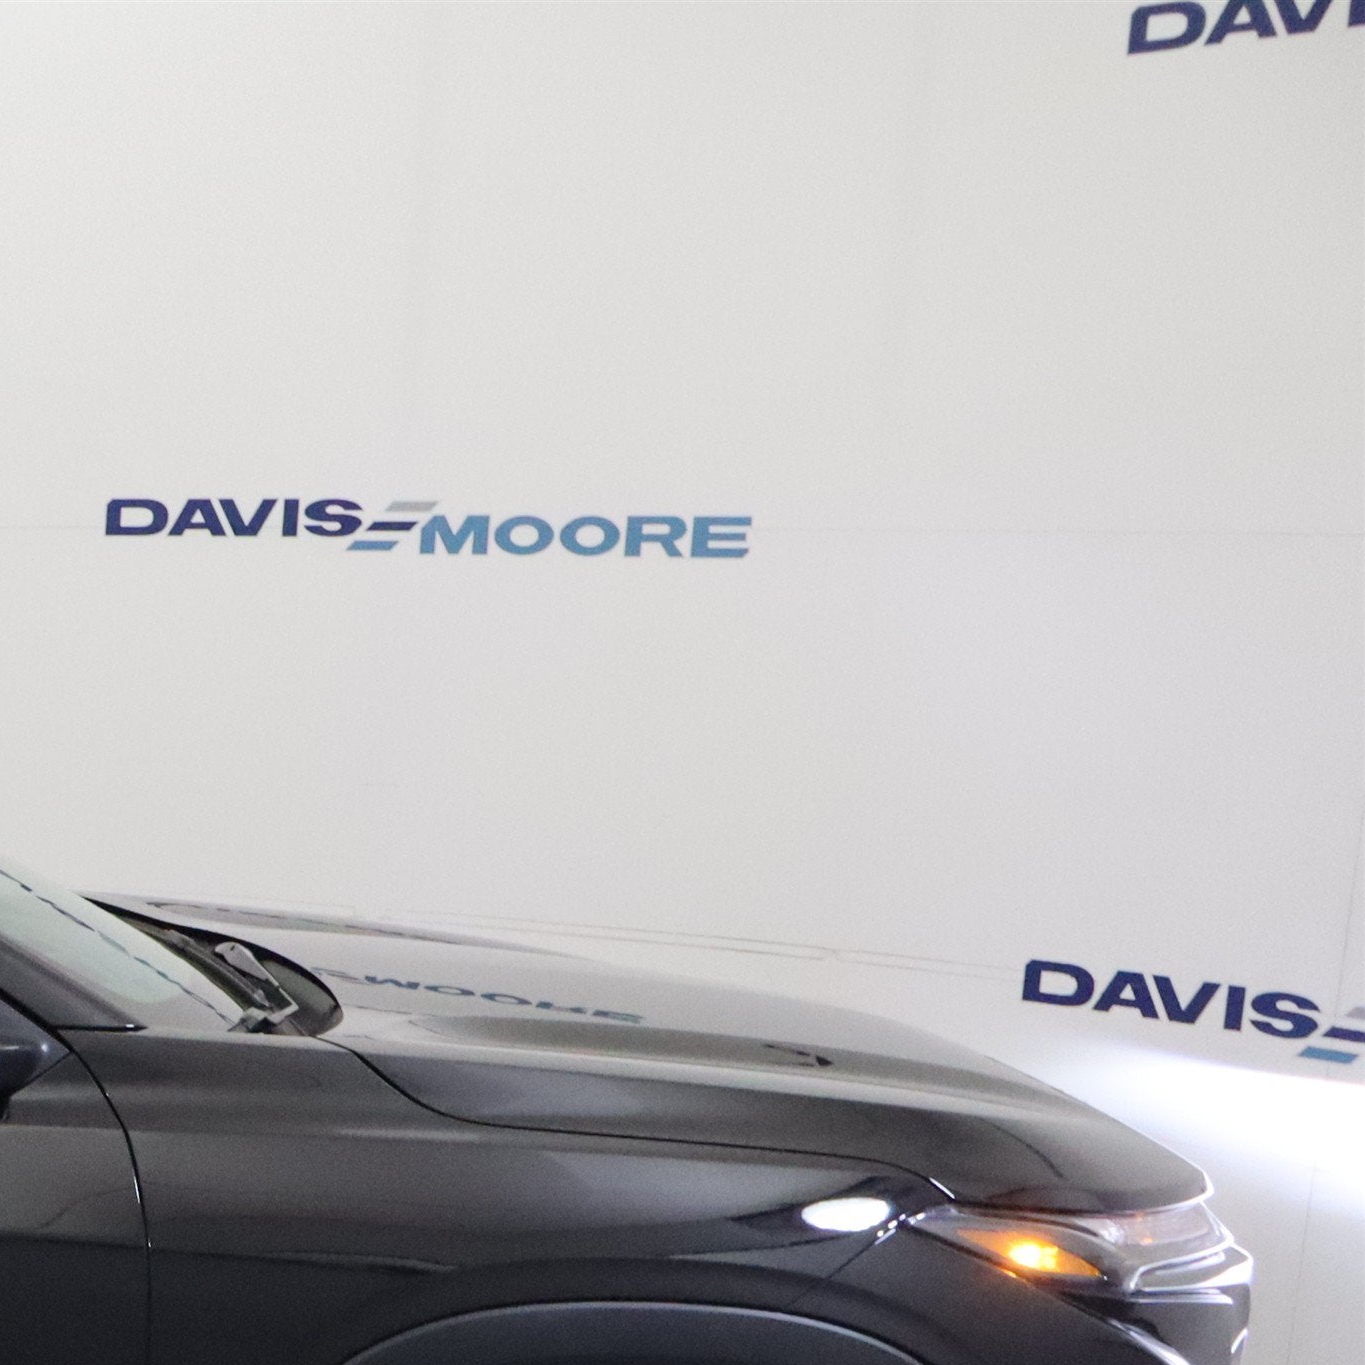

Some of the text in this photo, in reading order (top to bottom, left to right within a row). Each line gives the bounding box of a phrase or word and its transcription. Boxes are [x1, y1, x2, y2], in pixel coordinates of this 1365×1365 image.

[105, 498, 753, 559] DAVIS MOORE
[1021, 958, 1321, 1039] DAVIS
